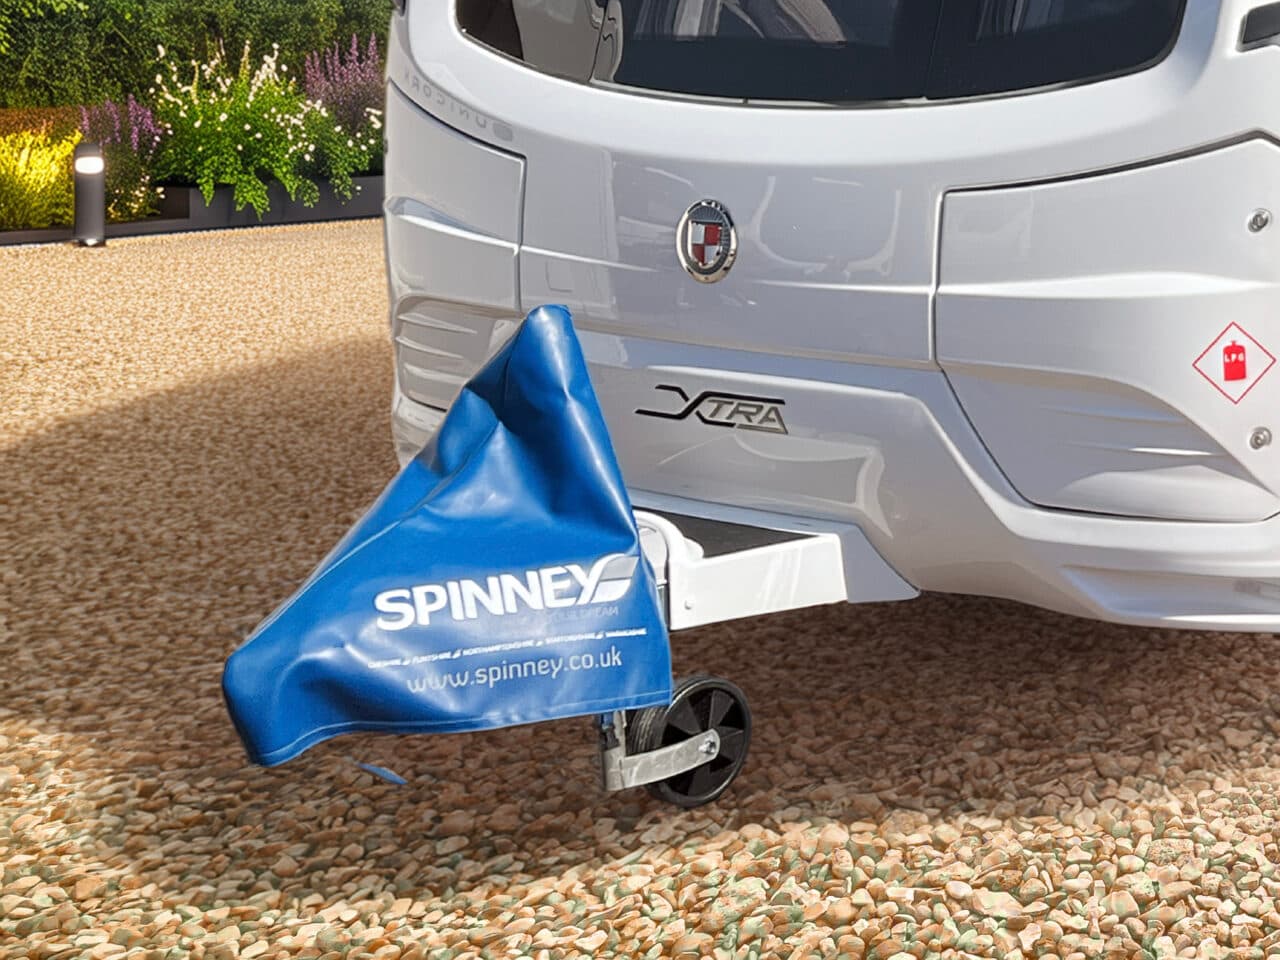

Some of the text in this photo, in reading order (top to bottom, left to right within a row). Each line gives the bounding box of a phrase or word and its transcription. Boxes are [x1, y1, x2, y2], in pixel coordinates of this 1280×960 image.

[1224, 351, 1245, 364] LPG
[634, 384, 789, 435] XTRA
[374, 553, 632, 631] SPINNEY
[406, 645, 623, 694] www.spinney.co.uk
